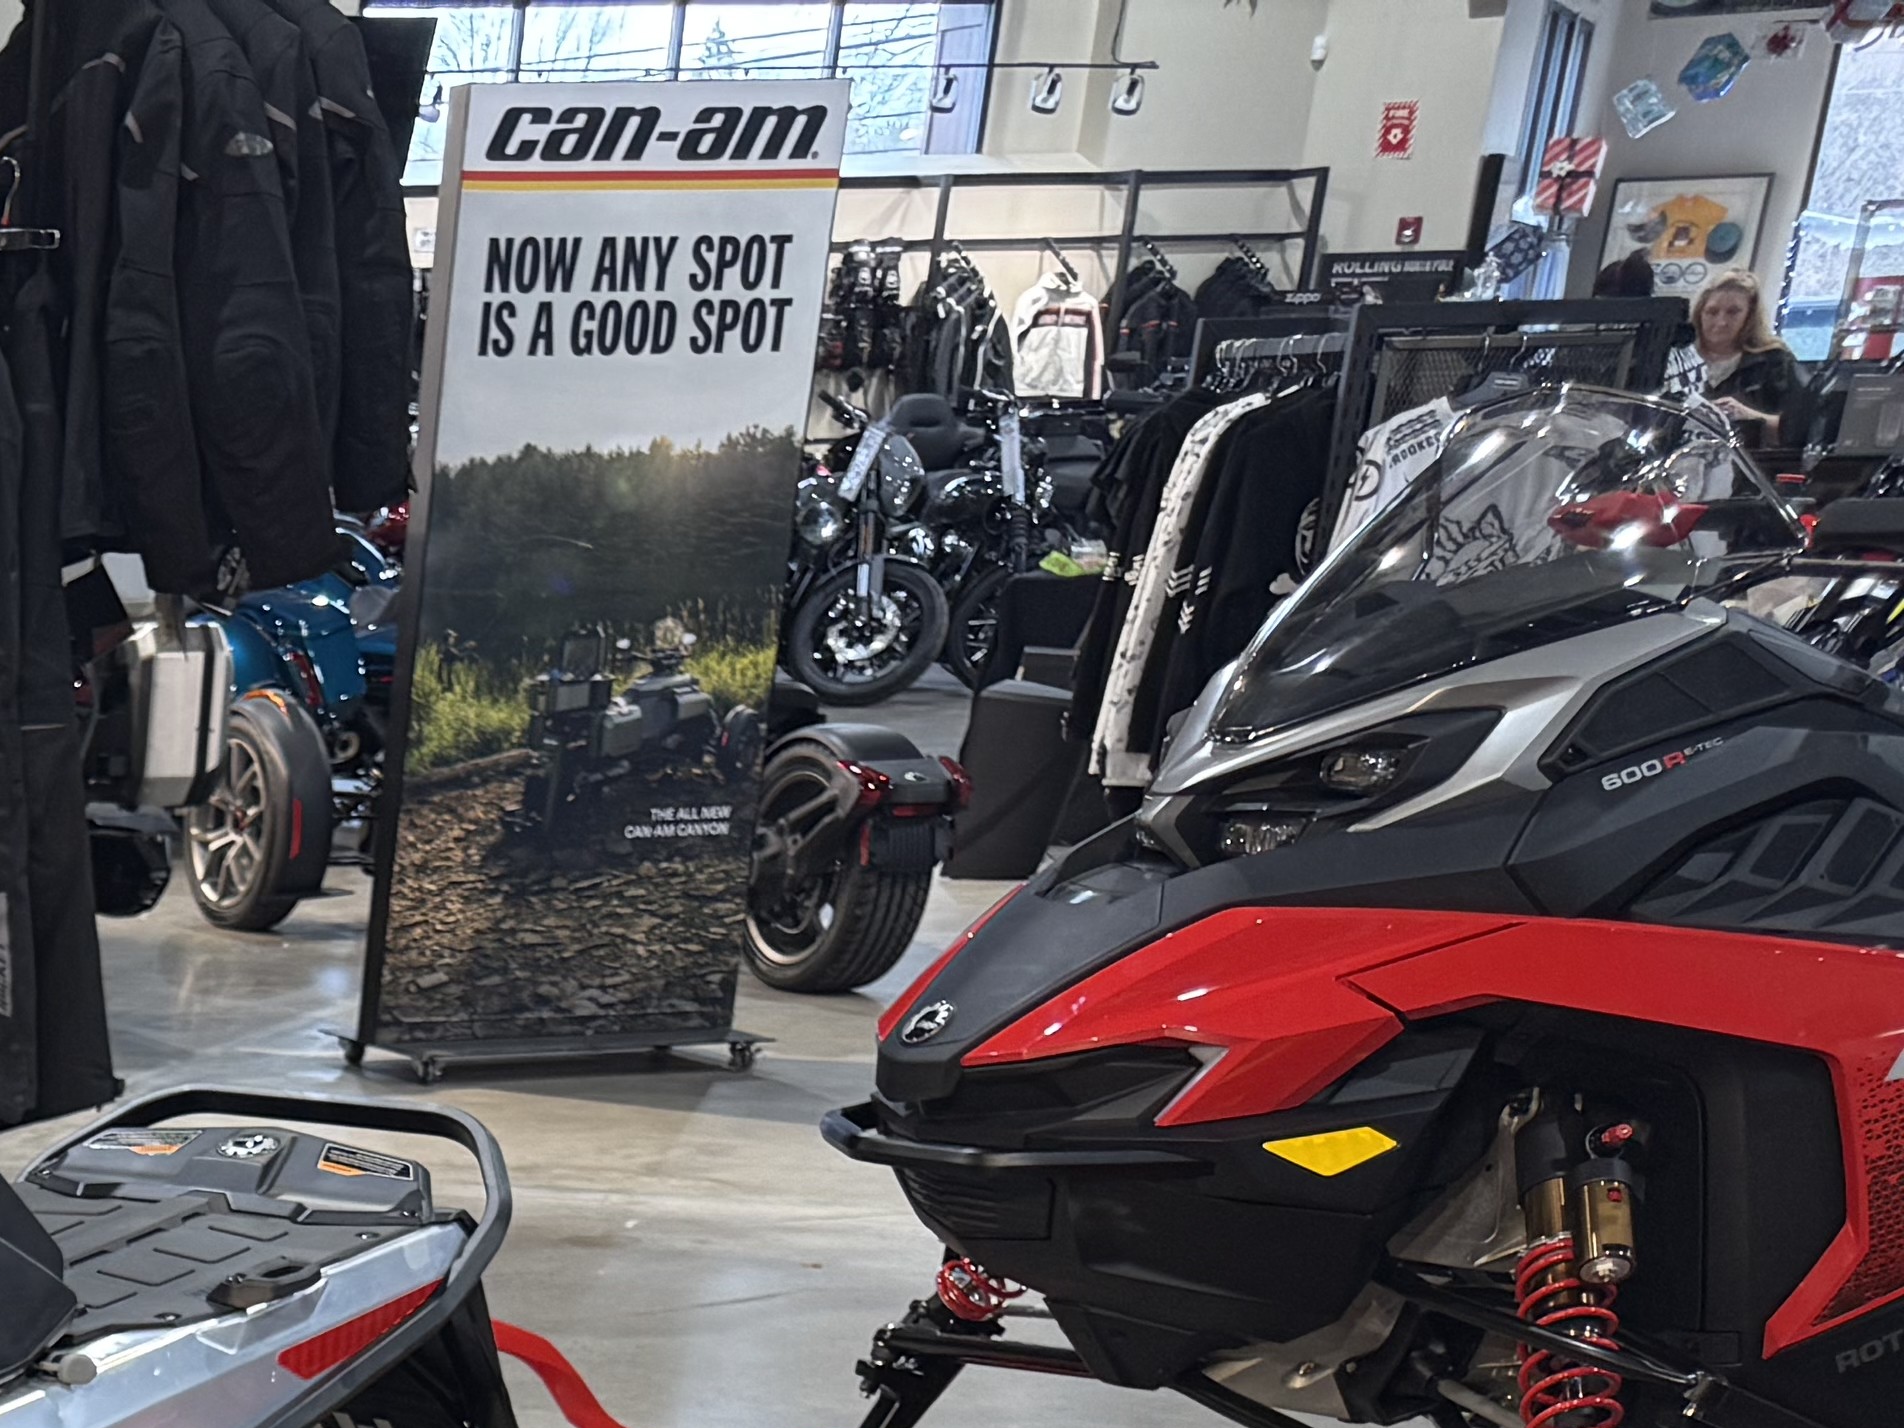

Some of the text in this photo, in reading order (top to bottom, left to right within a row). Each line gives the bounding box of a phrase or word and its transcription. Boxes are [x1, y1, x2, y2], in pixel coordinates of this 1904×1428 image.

[485, 104, 829, 162] can-am
[484, 233, 794, 294] NOW ANY SPOT
[477, 297, 794, 358] IS A GOOD SPOT
[649, 804, 732, 821] THE ALL NEW
